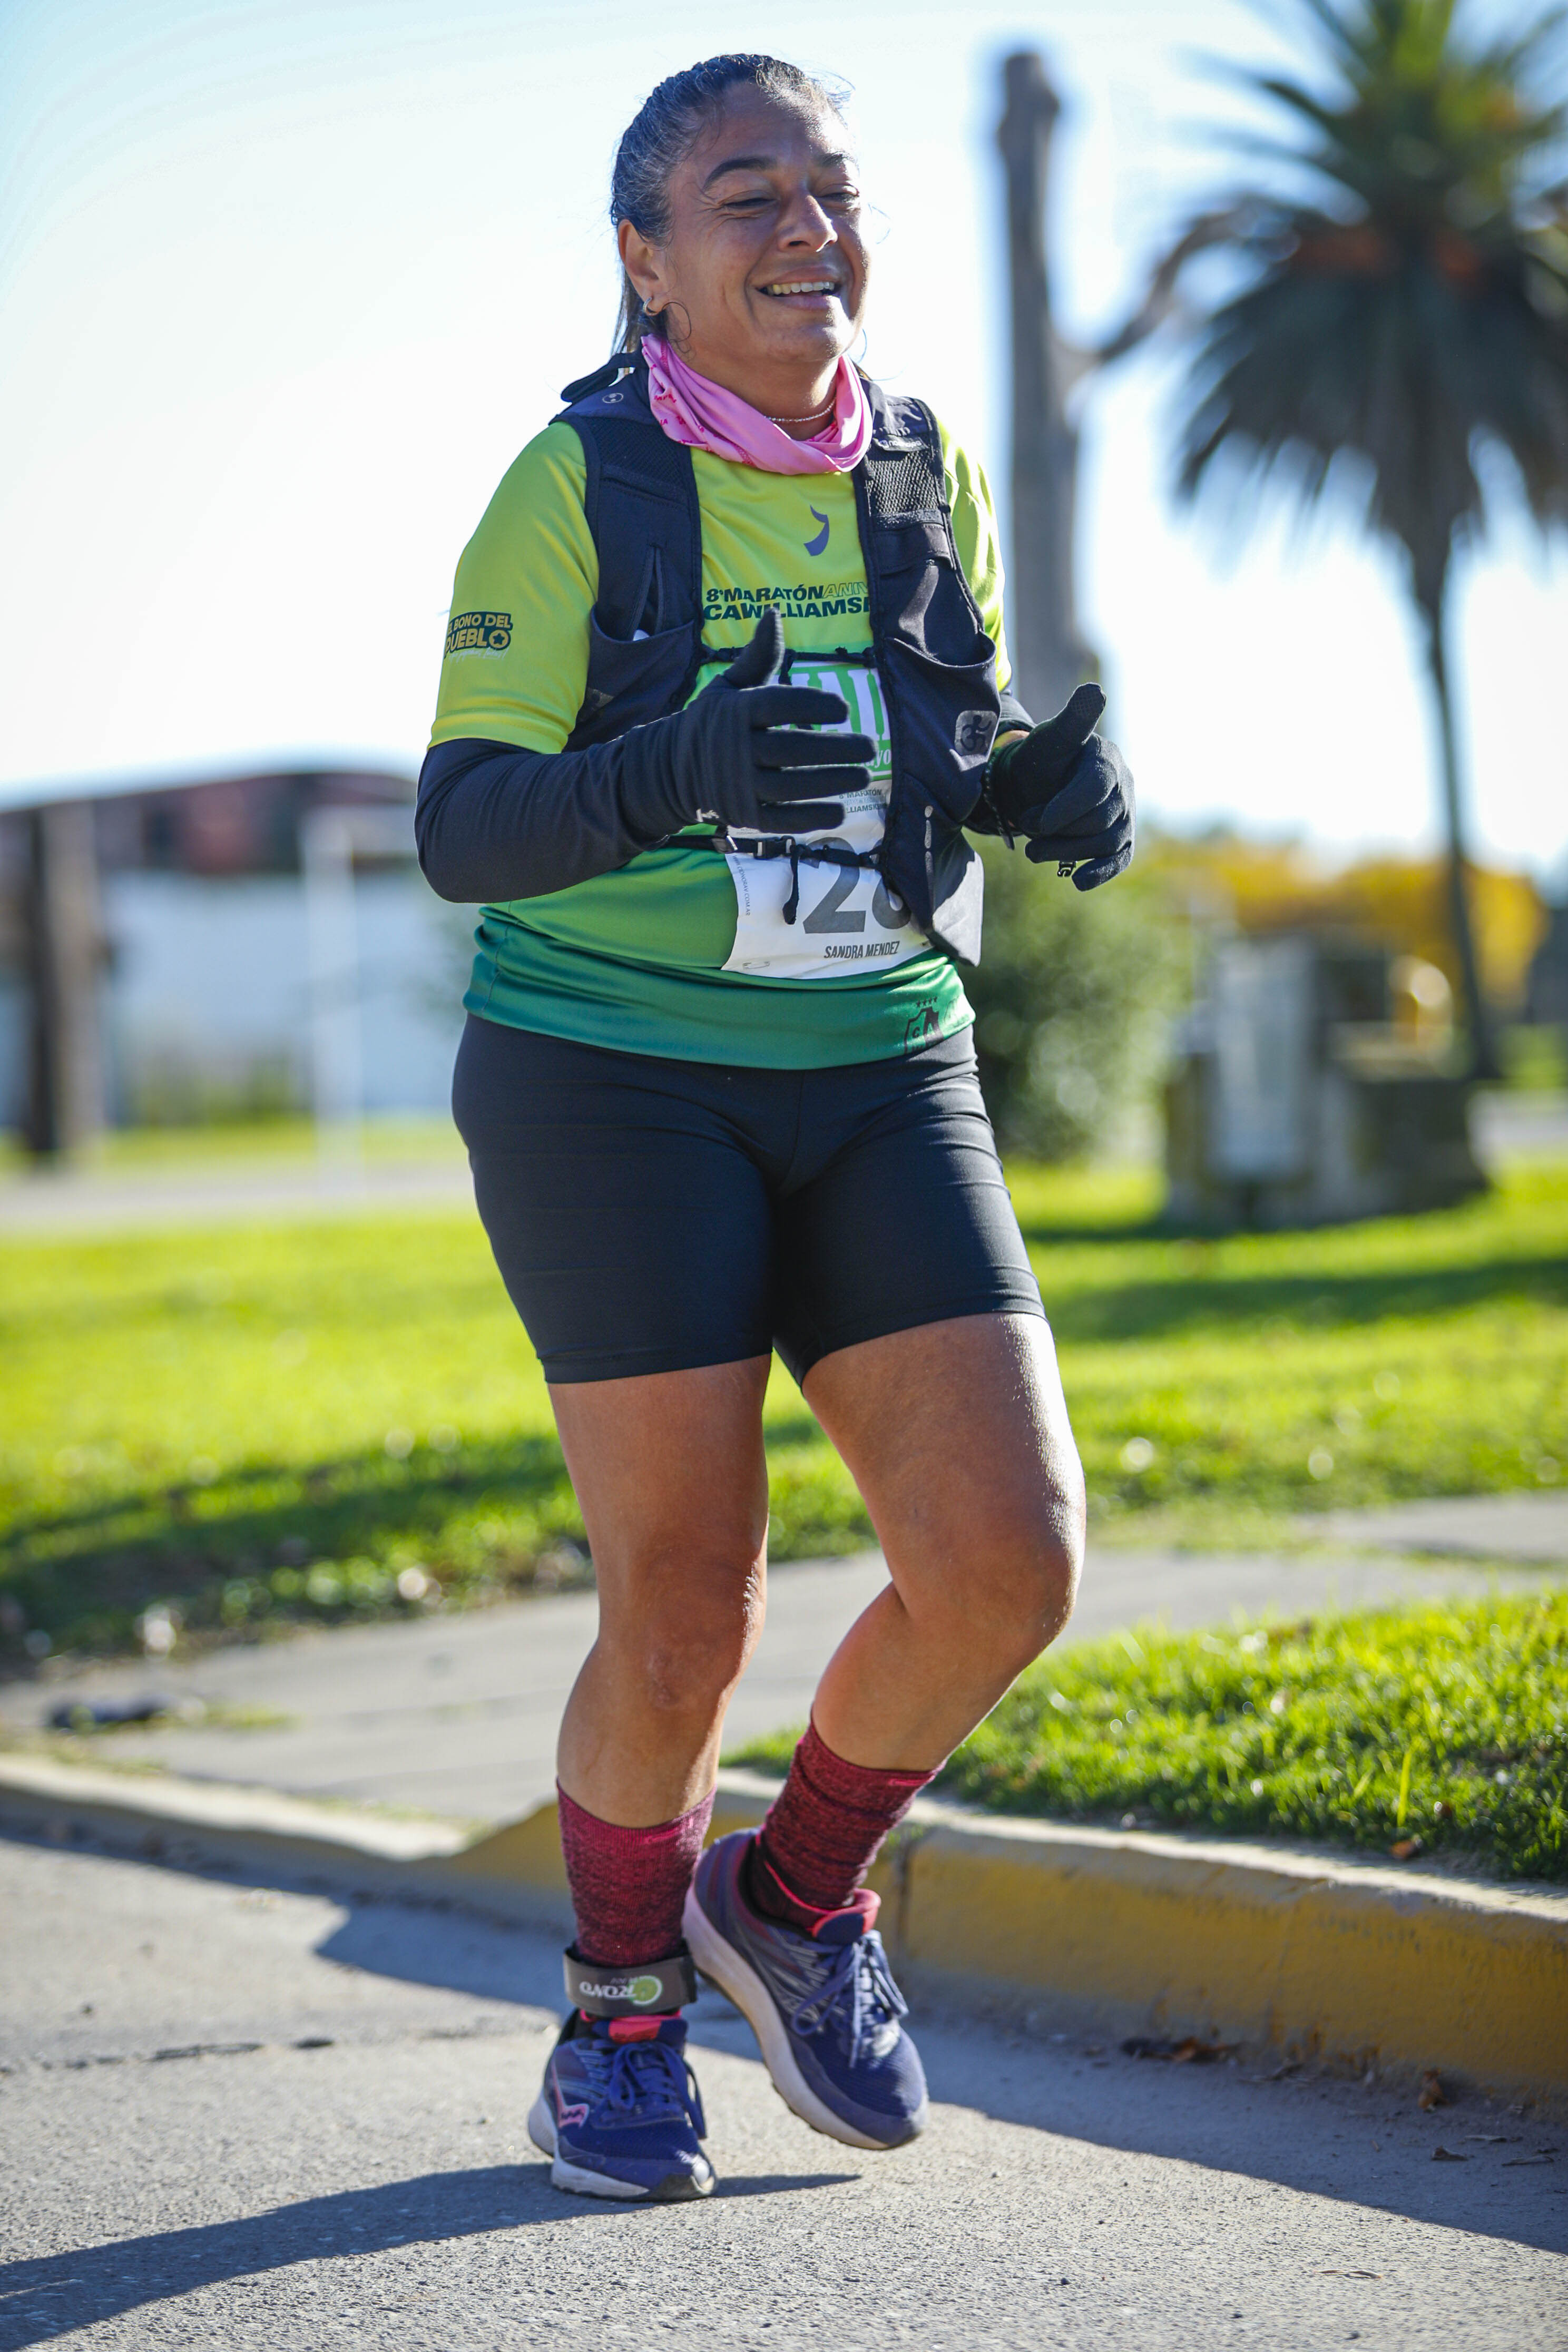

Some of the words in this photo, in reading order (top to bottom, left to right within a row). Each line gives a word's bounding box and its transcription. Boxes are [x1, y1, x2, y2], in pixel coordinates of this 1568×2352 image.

[724, 584, 824, 602] MARATÓN
[454, 614, 482, 631] BONO
[484, 614, 511, 628] DEL
[824, 945, 864, 959] SANDRA
[865, 940, 900, 957] MENDEZ
